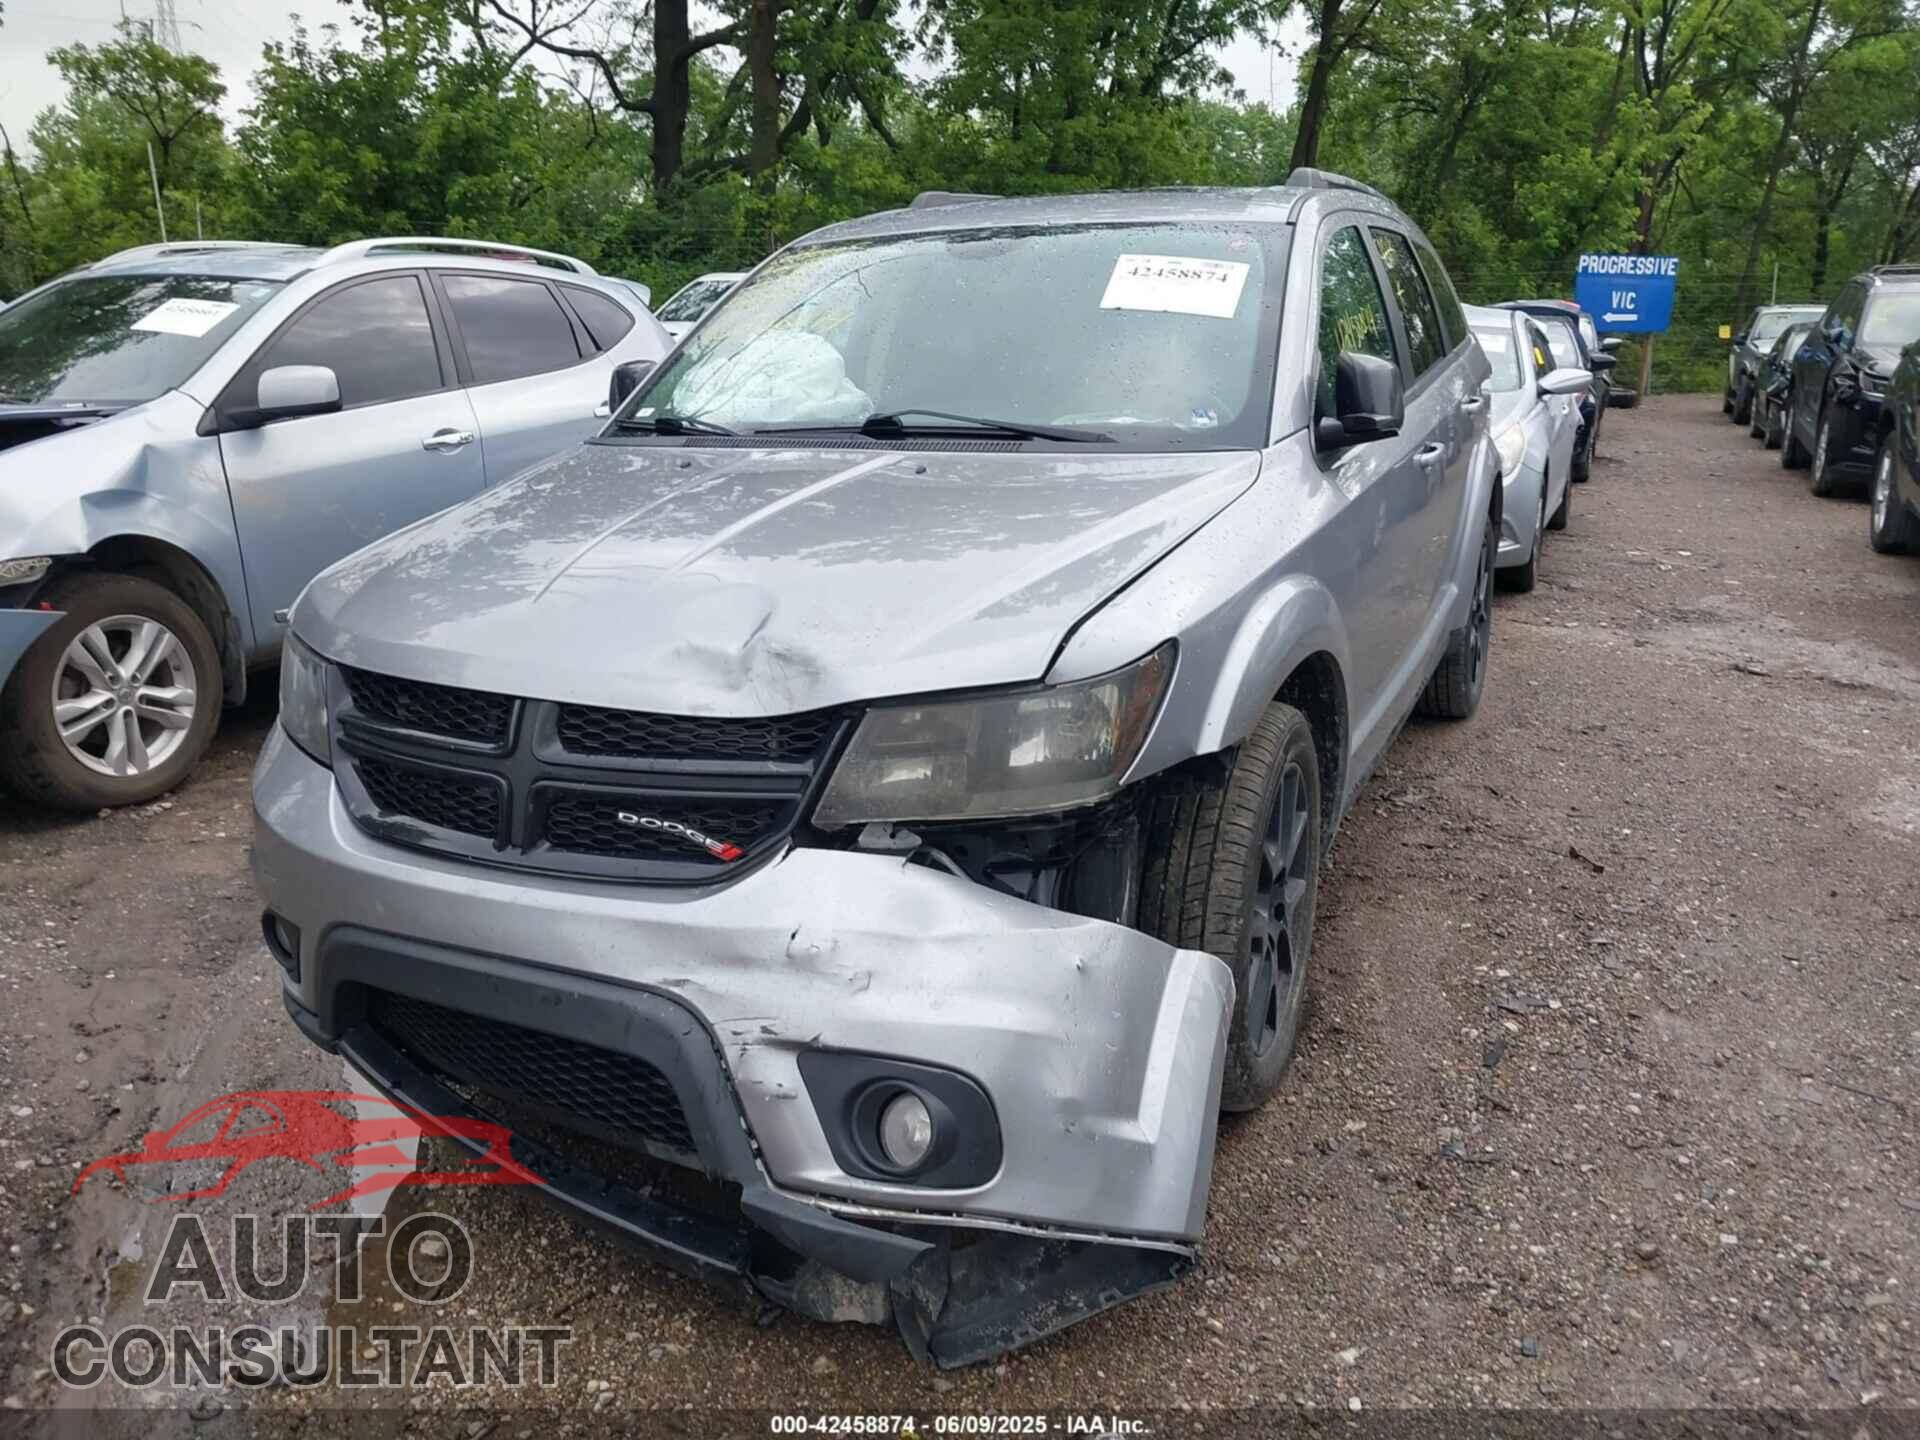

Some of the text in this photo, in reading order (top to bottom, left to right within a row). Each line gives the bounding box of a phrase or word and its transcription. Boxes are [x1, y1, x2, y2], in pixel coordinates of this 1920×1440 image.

[1579, 255, 1679, 275] PROGRESSIVE
[1127, 267, 1228, 283] 42458874
[1611, 291, 1636, 309] VIC
[618, 812, 724, 854] DODGE
